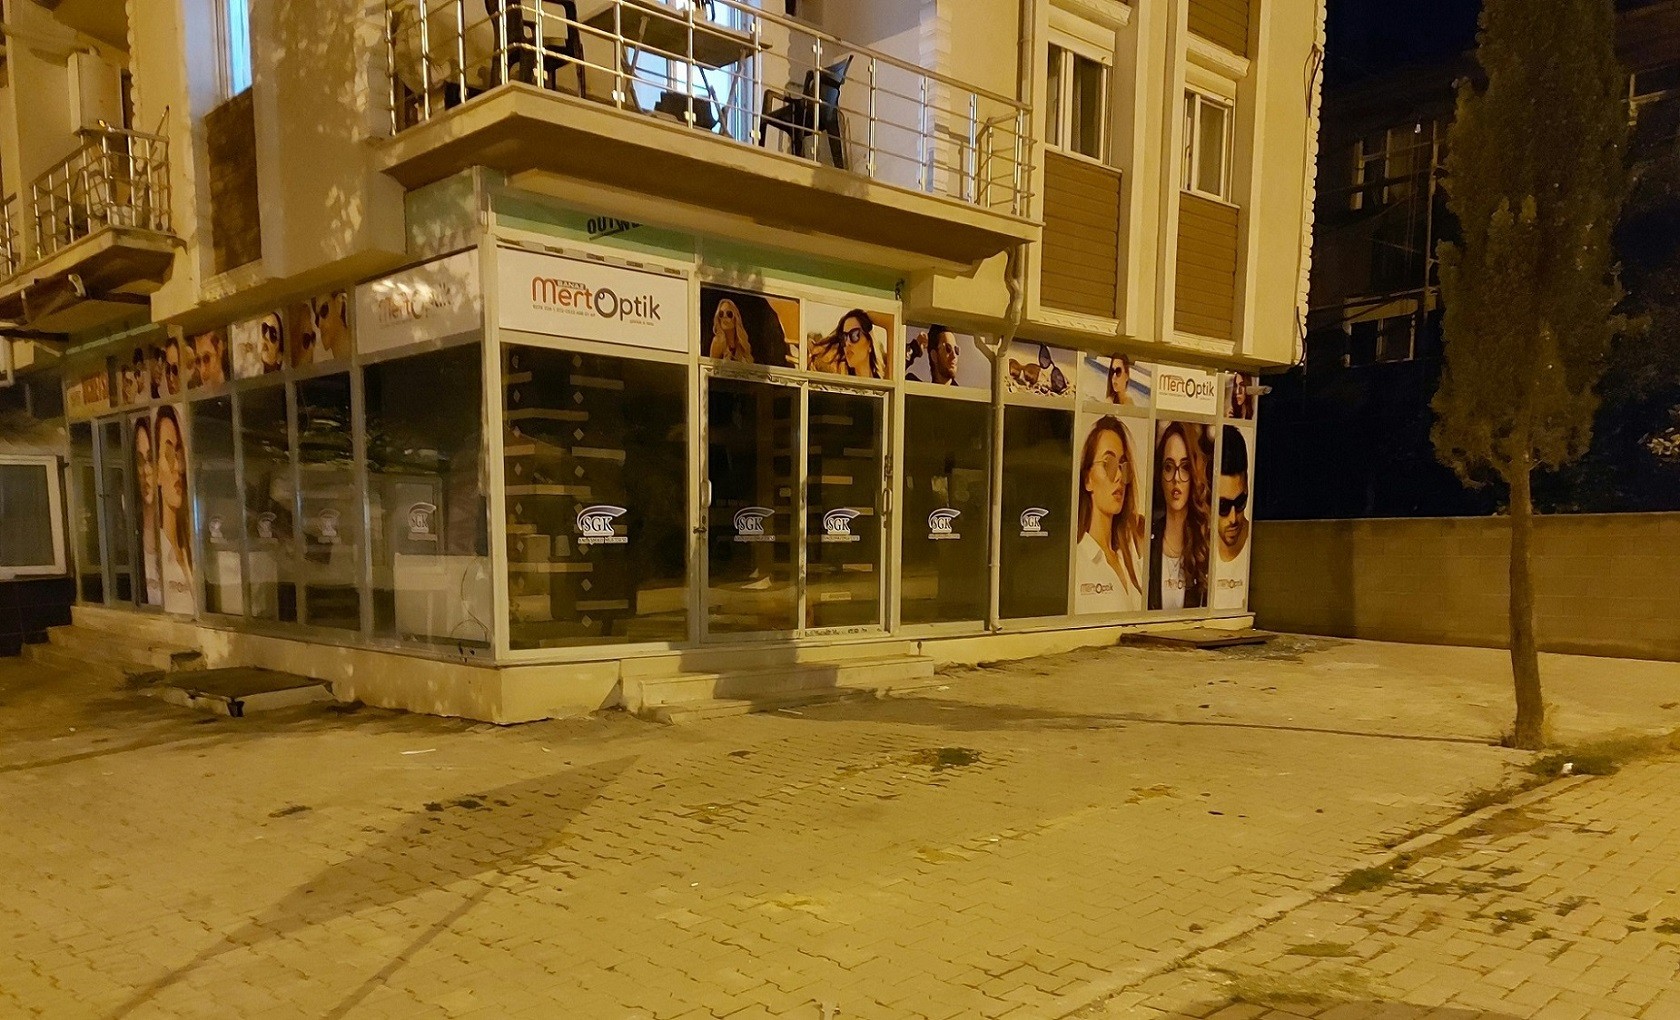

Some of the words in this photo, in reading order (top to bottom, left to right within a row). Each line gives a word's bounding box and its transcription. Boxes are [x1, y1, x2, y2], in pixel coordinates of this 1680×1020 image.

[583, 516, 613, 531] SGK
[739, 517, 763, 531] SGK
[828, 517, 850, 531] SGK
[931, 516, 952, 529] SGK
[1023, 516, 1040, 528] SGK
